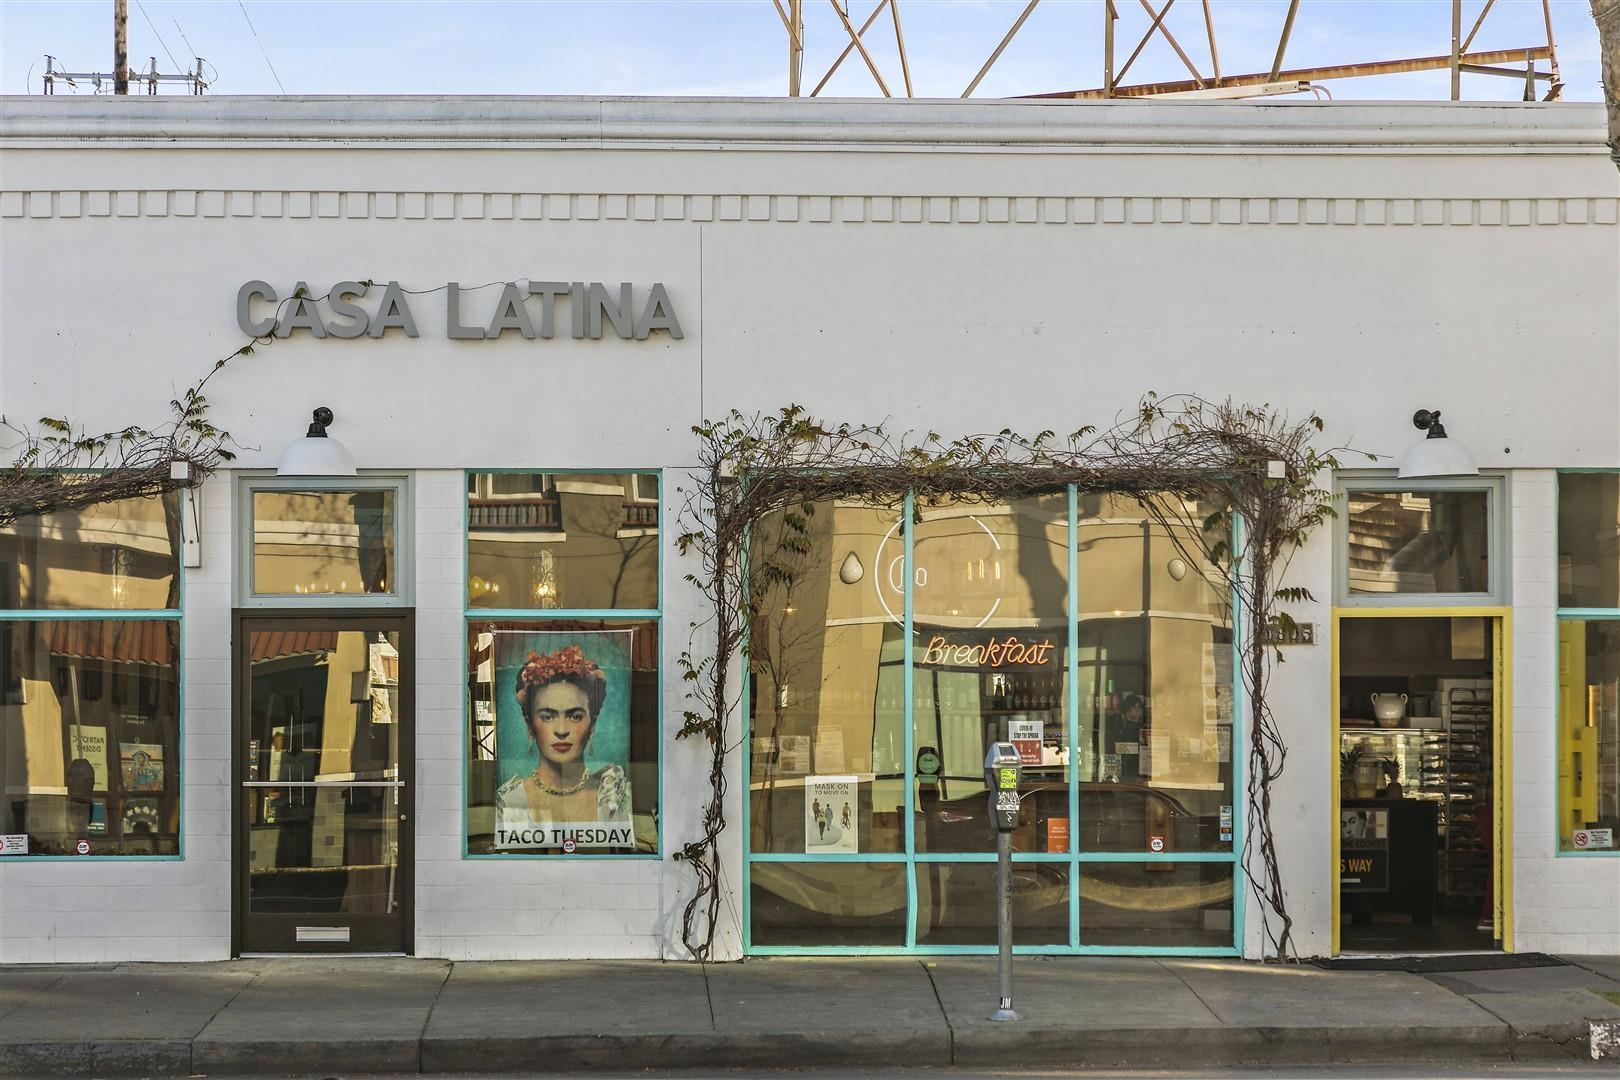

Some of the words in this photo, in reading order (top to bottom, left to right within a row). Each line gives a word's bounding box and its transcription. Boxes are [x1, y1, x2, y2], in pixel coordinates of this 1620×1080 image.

[236, 280, 419, 339] CASA
[447, 281, 684, 340] LATINA
[921, 636, 1054, 667] Breakfast
[497, 829, 545, 844] TACO
[551, 829, 631, 844] TUESDAY
[1348, 858, 1373, 873] WAY
